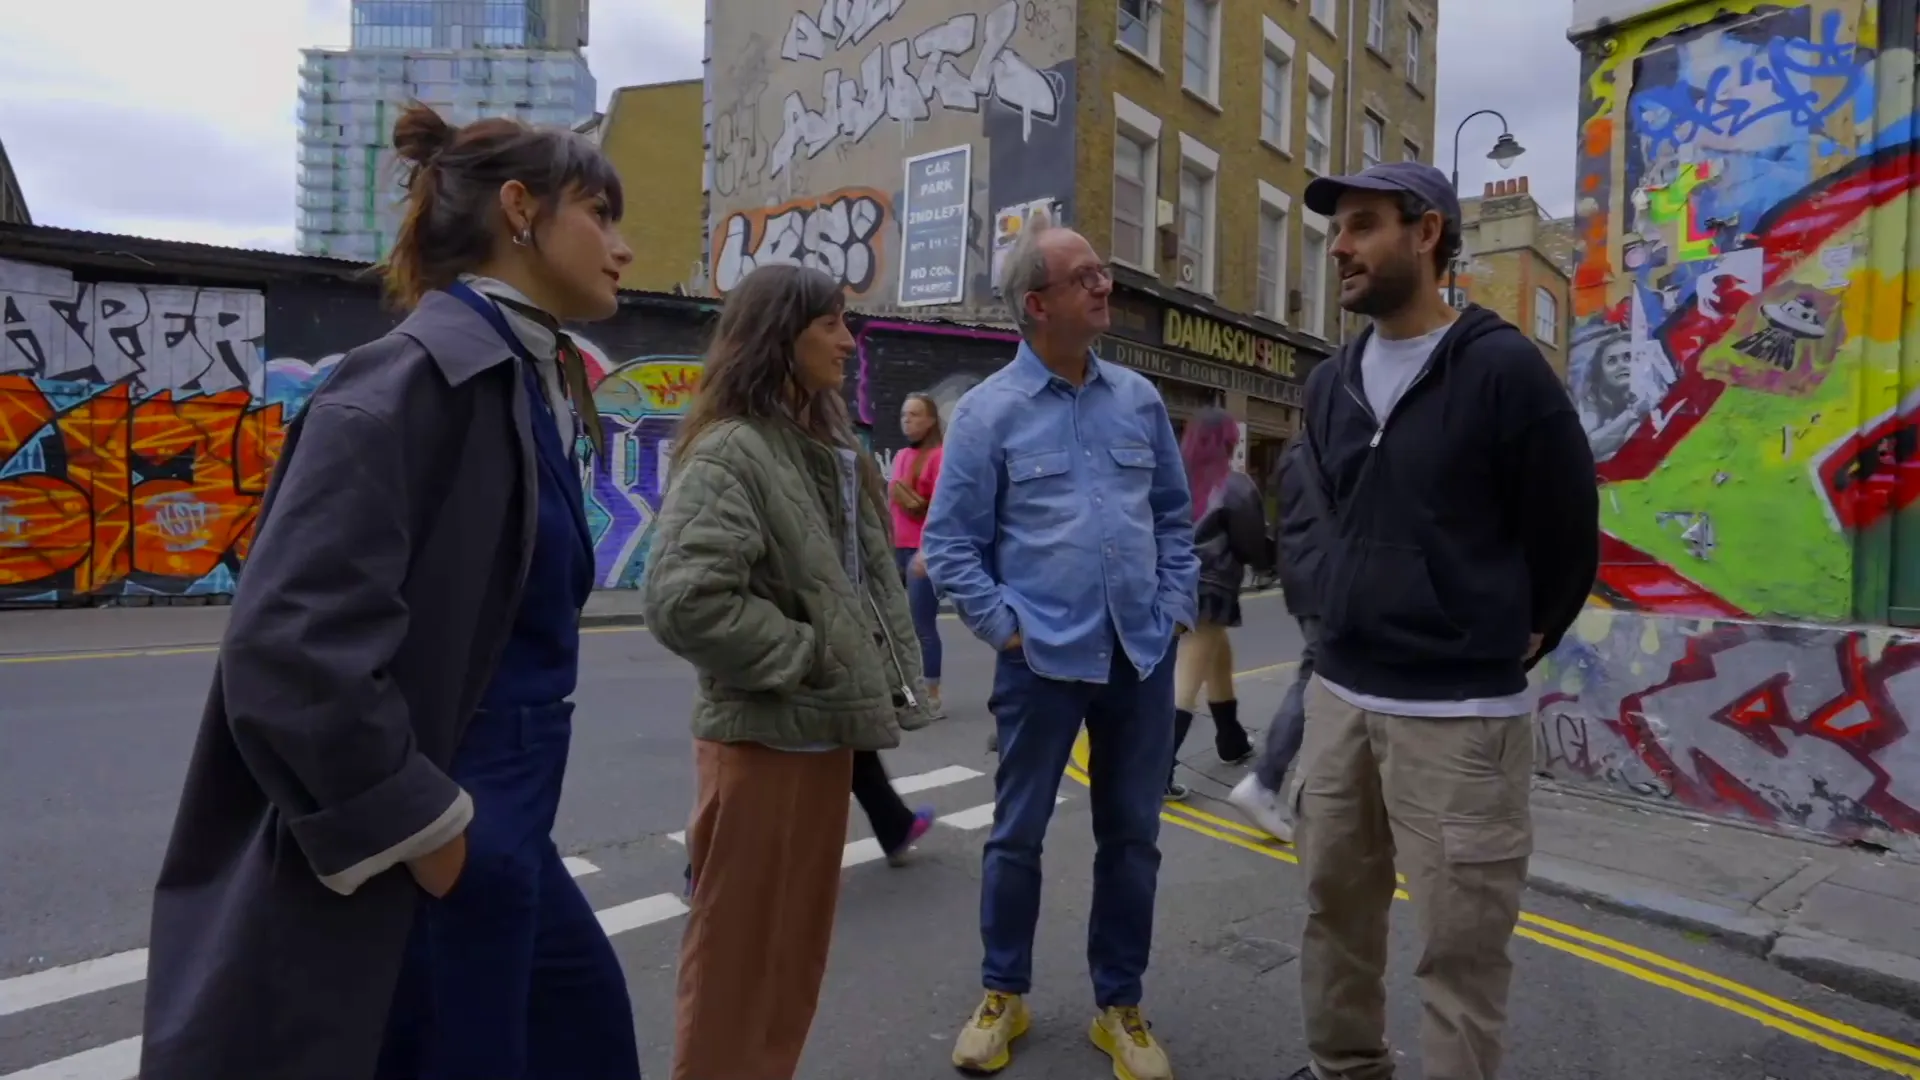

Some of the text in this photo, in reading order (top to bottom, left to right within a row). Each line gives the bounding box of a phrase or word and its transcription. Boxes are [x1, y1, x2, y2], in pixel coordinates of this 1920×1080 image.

[925, 161, 950, 177] CAR
[920, 179, 954, 197] PARK
[1116, 344, 1172, 373] DINING
[1180, 359, 1229, 387] ROOMS
